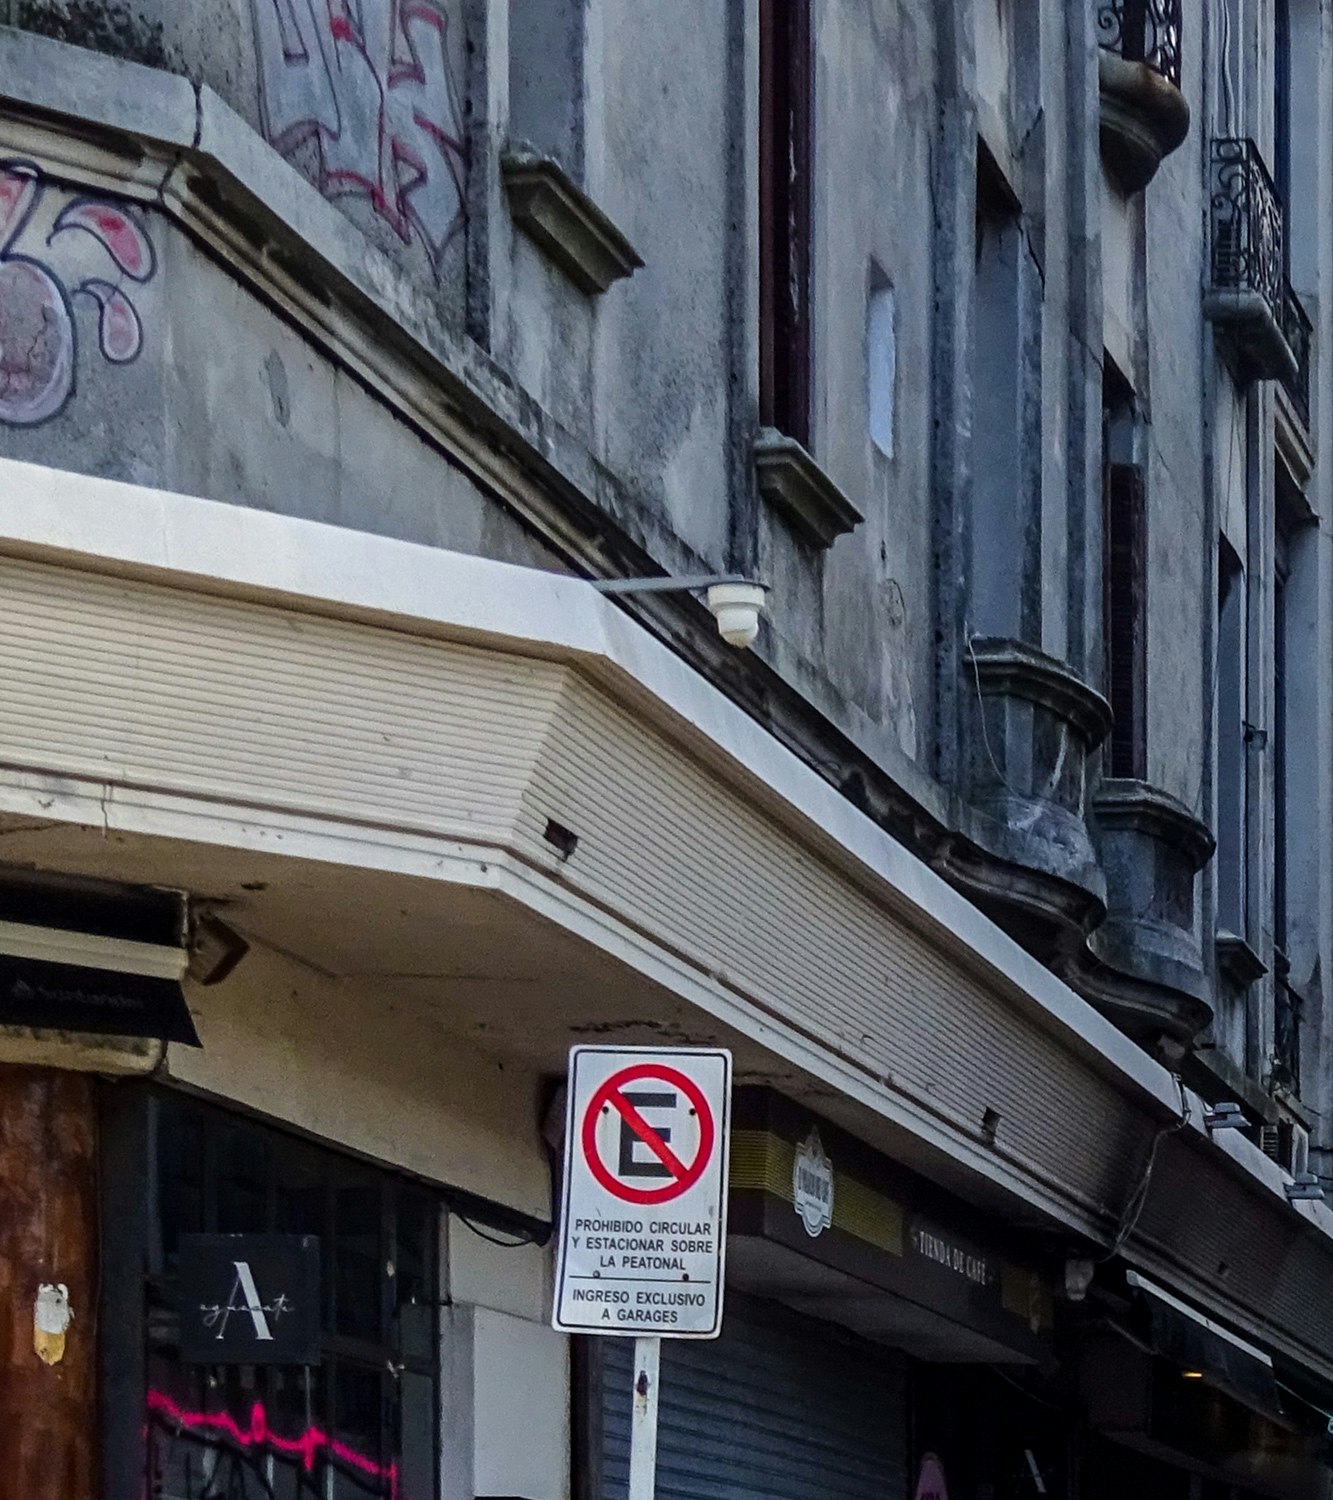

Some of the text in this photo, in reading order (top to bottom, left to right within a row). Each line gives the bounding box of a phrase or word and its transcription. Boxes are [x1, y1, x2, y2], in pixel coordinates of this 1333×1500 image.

[574, 1219, 712, 1236] PROHIBIDO CIRCULAR
[571, 1236, 713, 1254] Y ESTACIONAR SOBRE
[600, 1255, 686, 1271] LA PEATONAL
[919, 1231, 986, 1286] TIENDA DE CAFÉ
[573, 1289, 706, 1307] INGRESO EXCLUSIVO
[601, 1308, 678, 1323] A GARAGES
